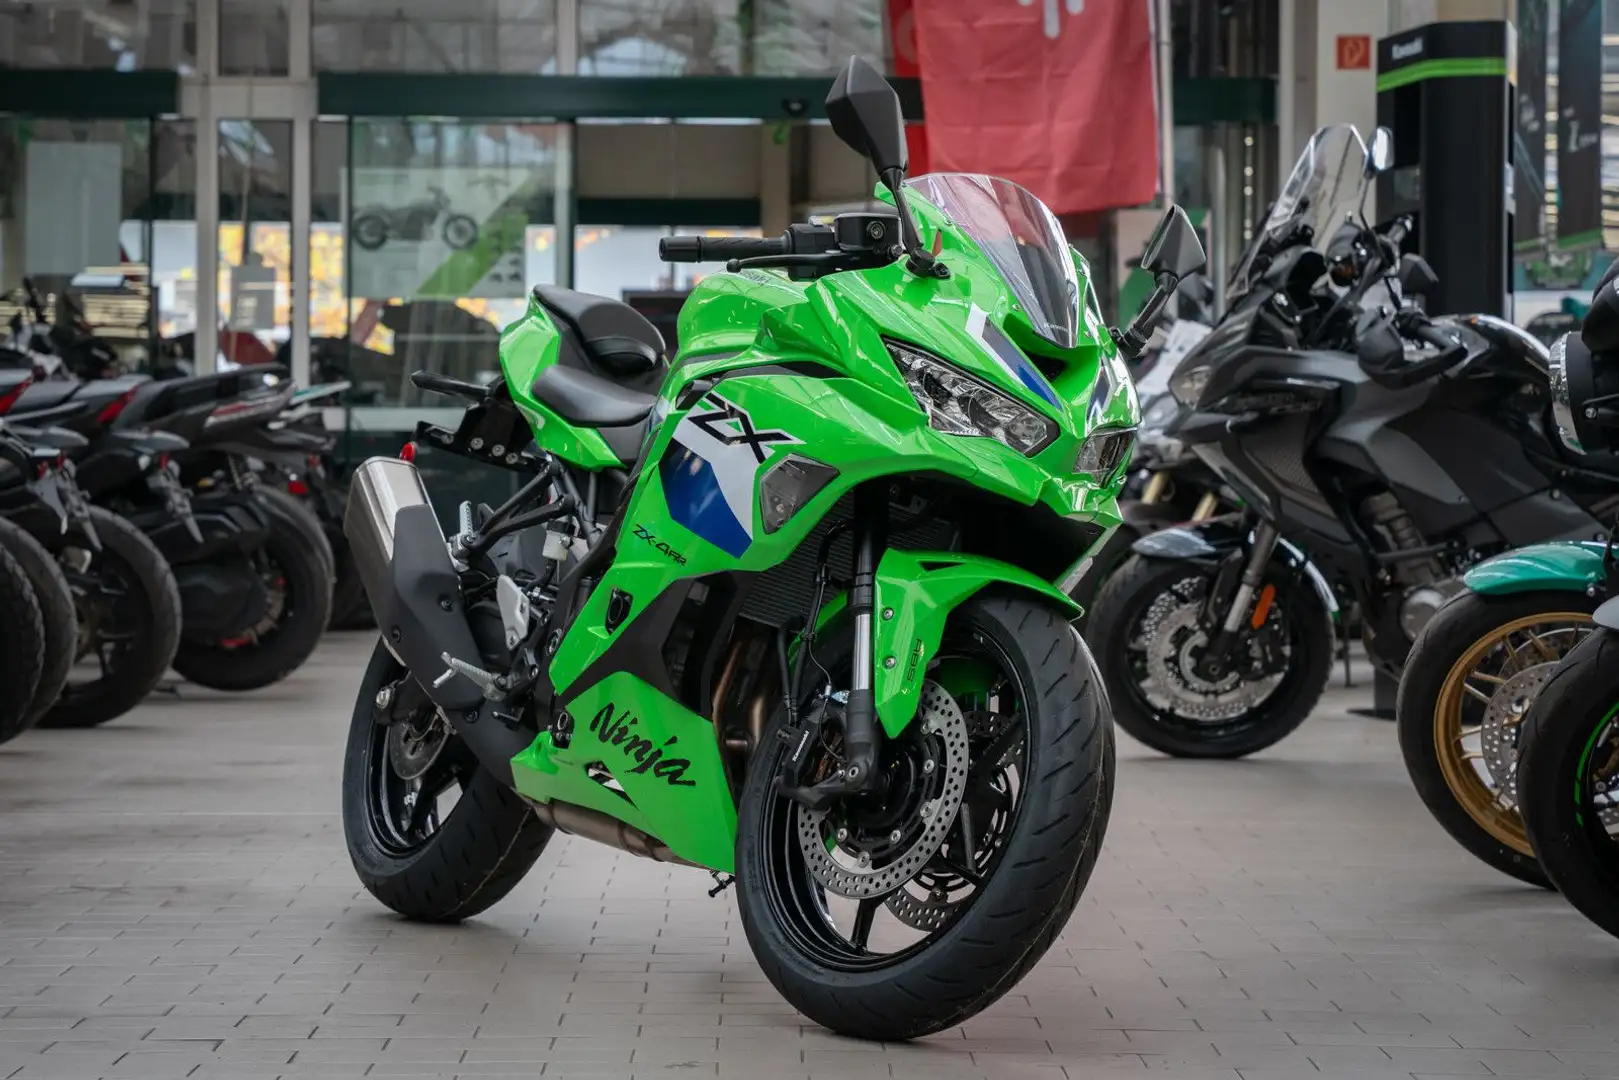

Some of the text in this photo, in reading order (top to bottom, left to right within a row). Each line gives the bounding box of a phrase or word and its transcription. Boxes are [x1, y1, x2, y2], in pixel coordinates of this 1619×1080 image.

[687, 392, 793, 464] ZX
[632, 523, 688, 567] ZX-4RR
[906, 637, 923, 682] ABS
[589, 701, 696, 787] Ninja
[792, 730, 810, 762] Kawasaki
